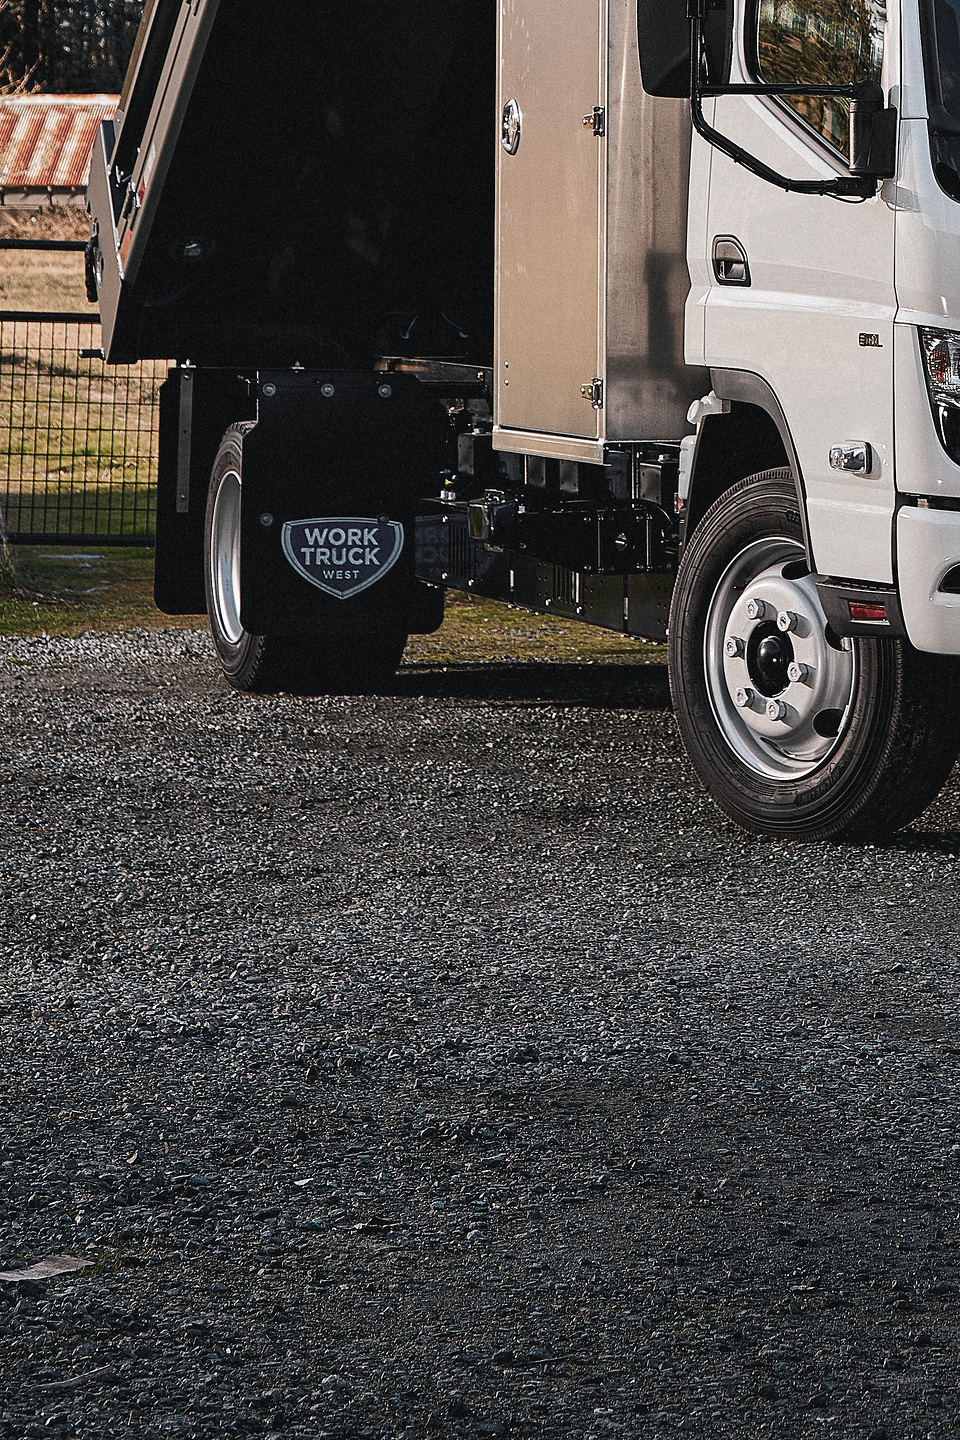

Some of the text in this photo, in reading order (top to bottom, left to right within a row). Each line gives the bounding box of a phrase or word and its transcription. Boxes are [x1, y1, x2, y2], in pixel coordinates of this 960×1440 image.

[304, 527, 379, 546] WORK
[300, 547, 381, 566] TRUCK
[322, 569, 360, 579] WEST
